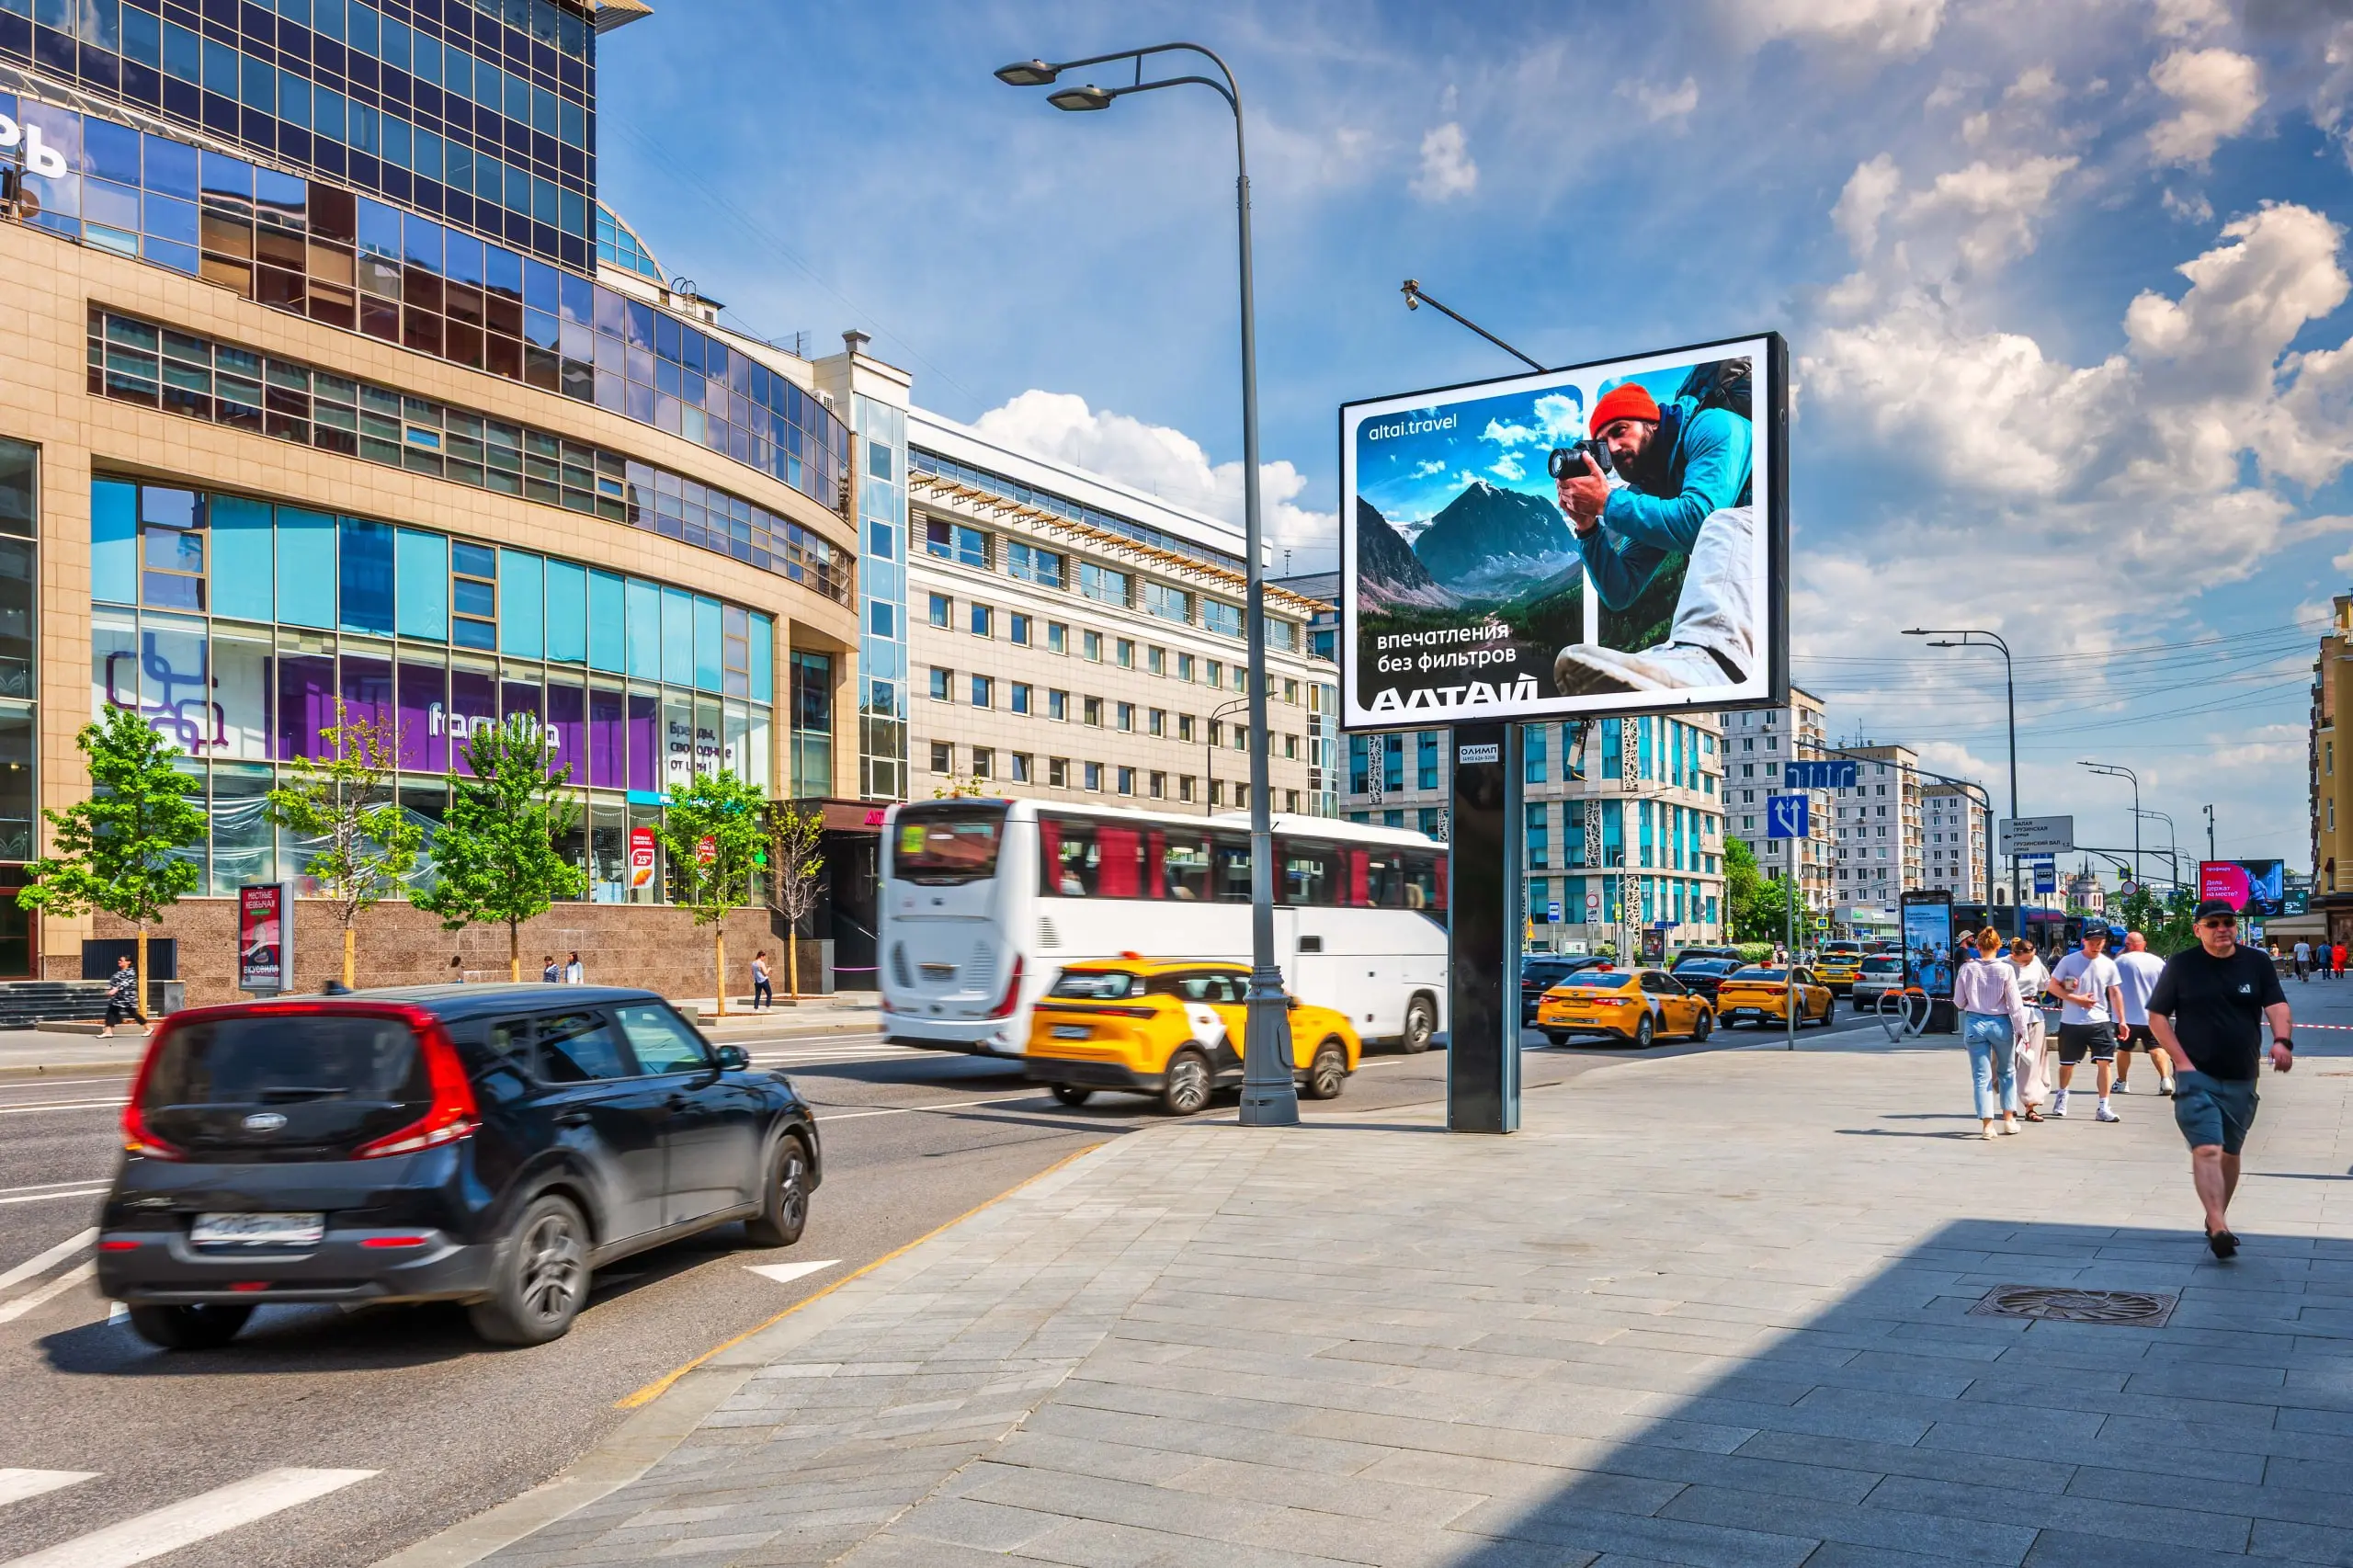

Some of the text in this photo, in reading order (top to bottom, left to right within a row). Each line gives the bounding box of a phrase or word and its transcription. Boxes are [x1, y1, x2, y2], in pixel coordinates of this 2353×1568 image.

[1369, 413, 1457, 440] altai.travel
[1377, 624, 1510, 650] впечатления
[1378, 647, 1517, 673] без фильтров
[1370, 672, 1538, 711] АЛТАЙ
[1461, 746, 1496, 756] ОЛИМП
